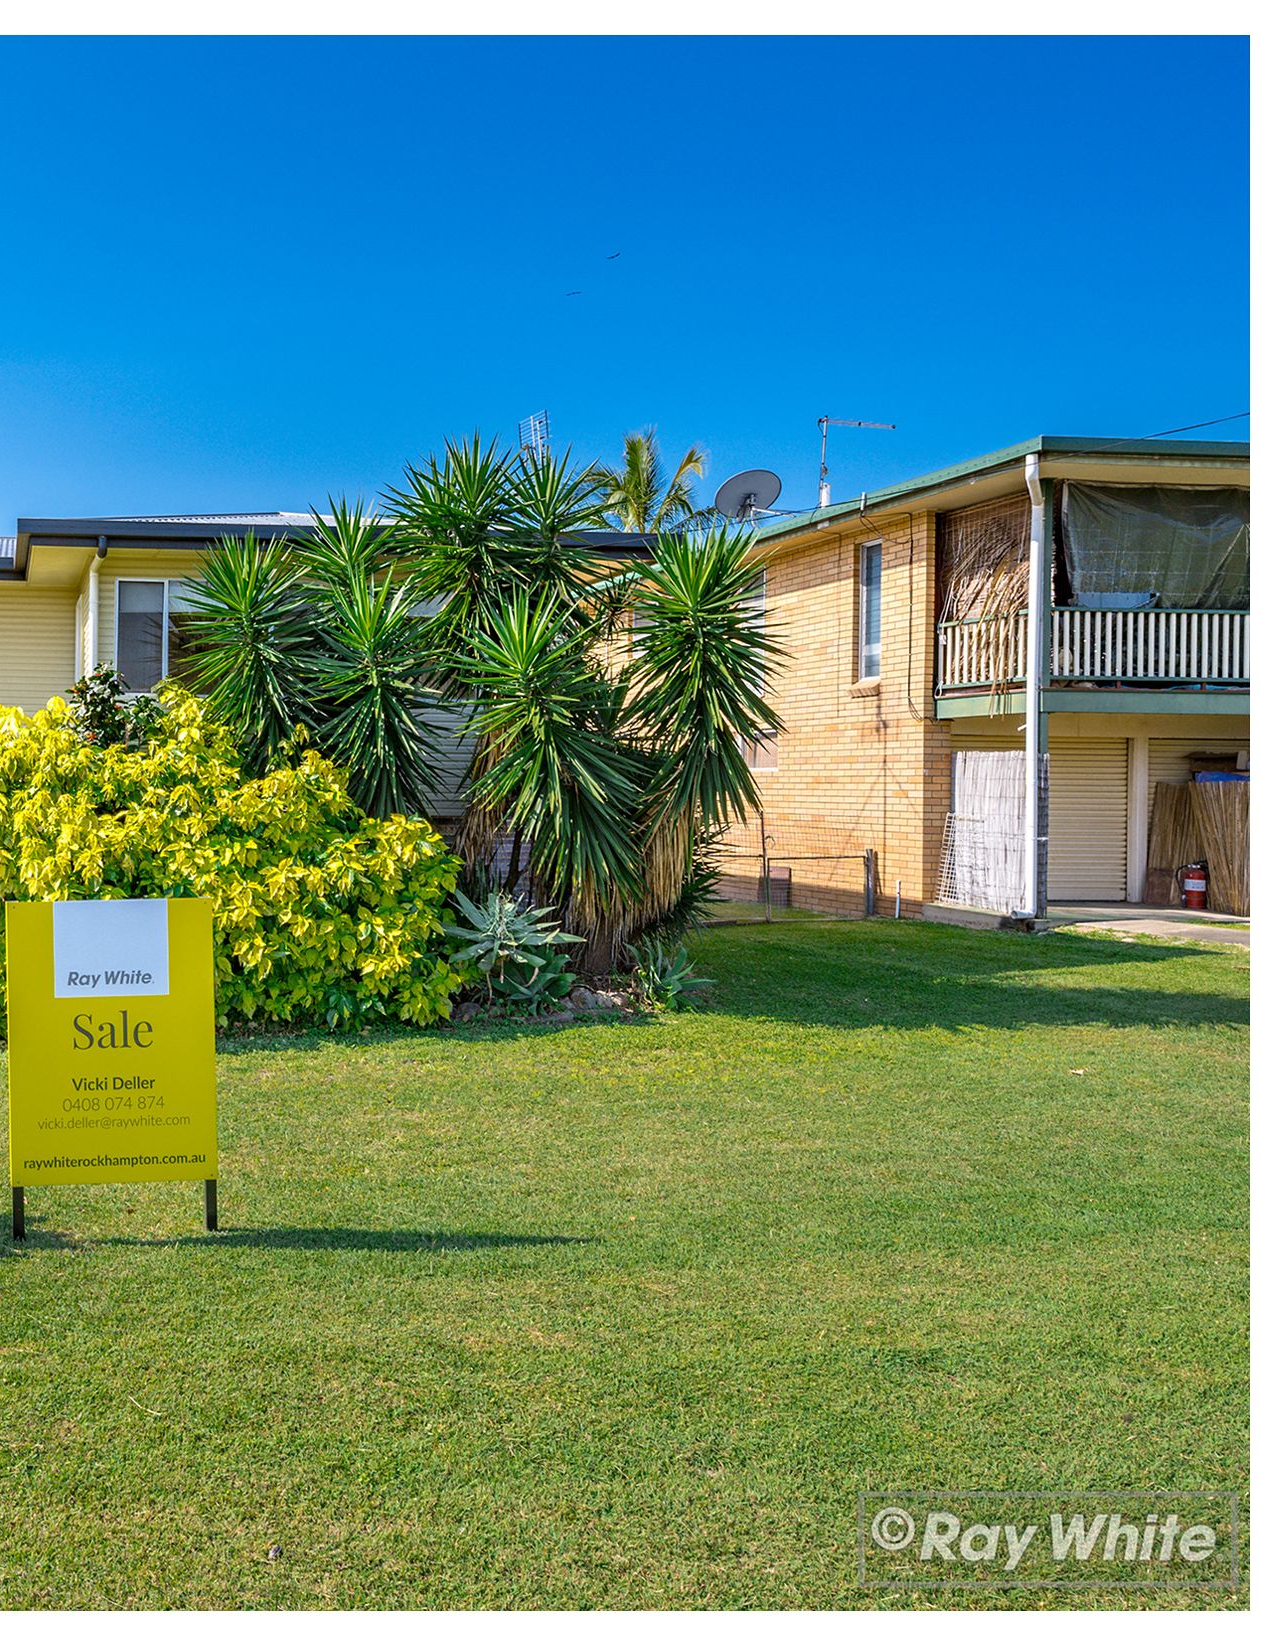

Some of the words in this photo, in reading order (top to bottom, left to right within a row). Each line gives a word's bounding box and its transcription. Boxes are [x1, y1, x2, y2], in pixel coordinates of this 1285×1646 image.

[67, 971, 101, 989] Ray
[104, 970, 152, 985] White
[73, 1009, 153, 1050] Sale
[72, 1077, 108, 1091] Vicki
[112, 1076, 155, 1090] Deller
[62, 1097, 101, 1112] 0408
[105, 1096, 133, 1111] 074
[137, 1095, 165, 1110] 874
[37, 1114, 190, 1130] vicki.deller@raywhite.com
[23, 1153, 206, 1171] raywhiterockhampton.com.au
